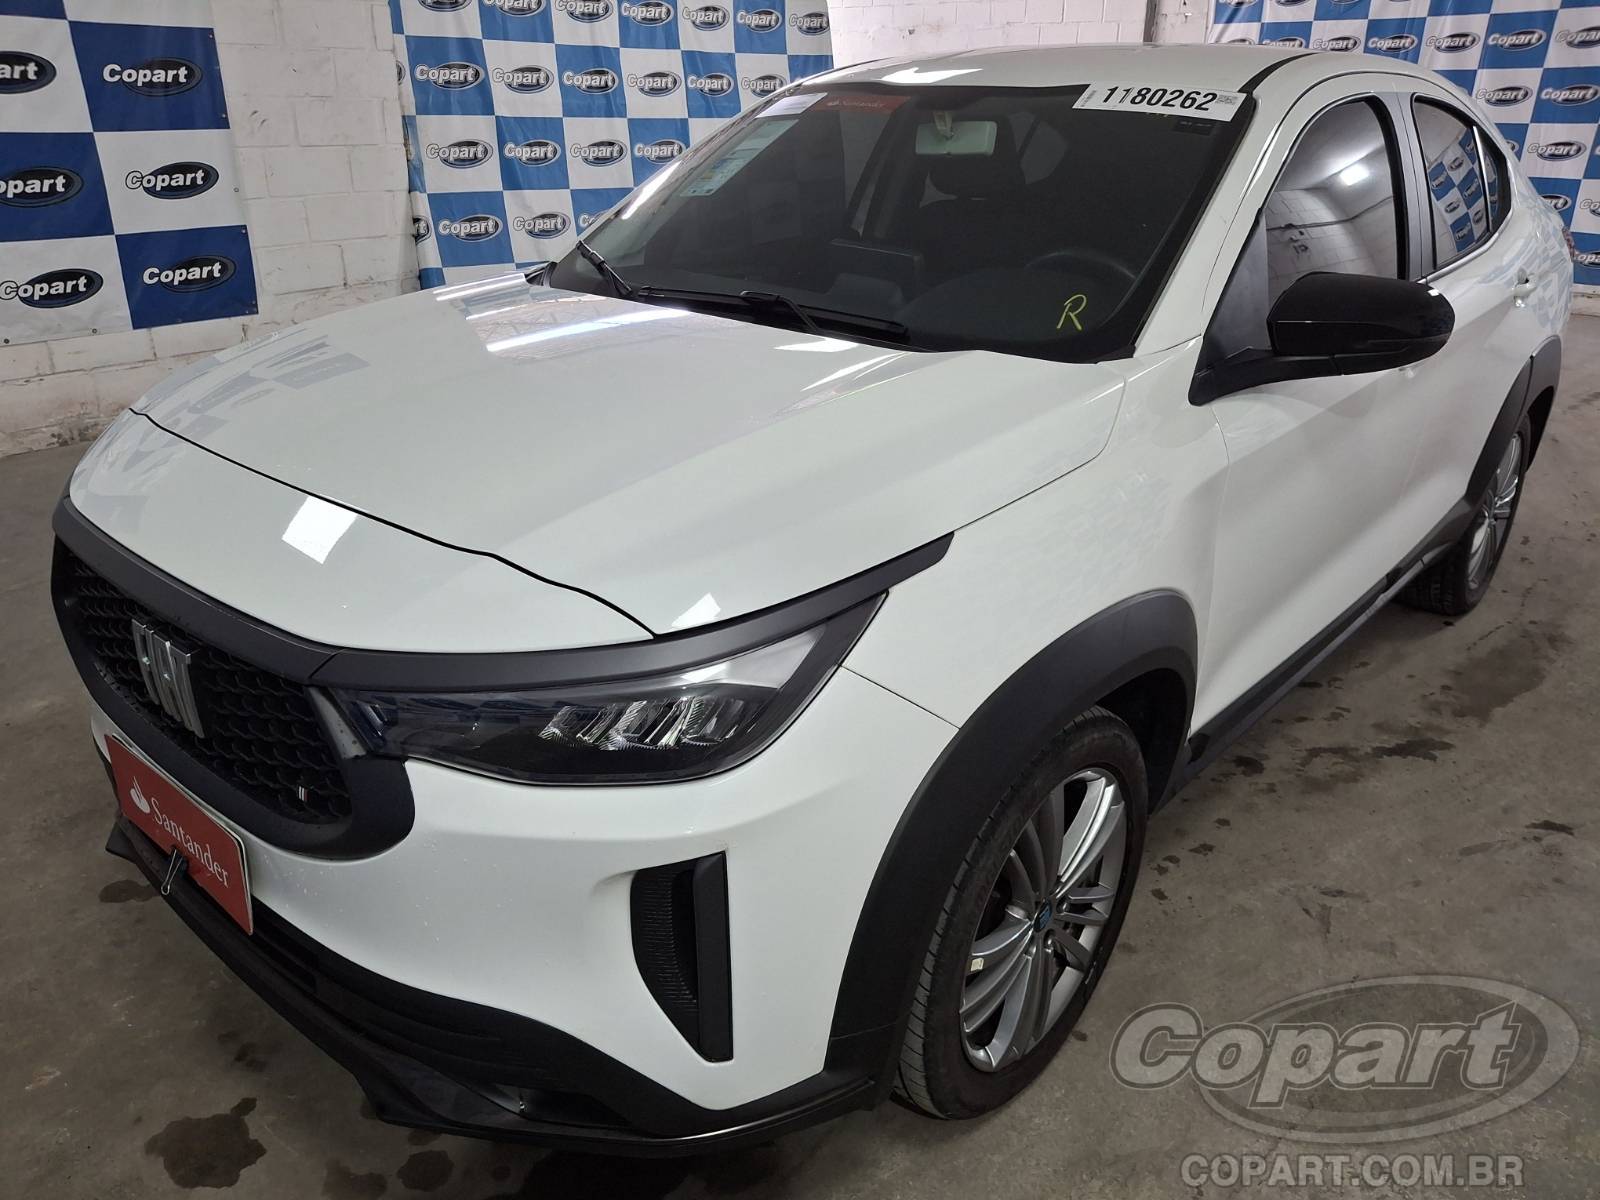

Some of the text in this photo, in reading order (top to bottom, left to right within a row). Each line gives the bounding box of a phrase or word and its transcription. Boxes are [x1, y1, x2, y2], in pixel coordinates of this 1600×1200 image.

[556, 0, 607, 14] Copart
[622, 3, 668, 20] Copart
[683, 7, 725, 23] Copart
[737, 11, 777, 27] Copart
[789, 14, 829, 29] Copart
[1313, 39, 1355, 50] Copart
[1368, 36, 1414, 50] Copart
[1426, 35, 1472, 49] Copart
[1488, 31, 1539, 47] Copart
[103, 64, 188, 86] Copart
[415, 65, 475, 85] Copart
[492, 68, 546, 84] Copart
[562, 71, 613, 87] Copart
[627, 73, 674, 91] Copart
[687, 75, 729, 91] Copart
[741, 77, 781, 91] Copart
[1102, 86, 1218, 111] 1180262
[1477, 88, 1527, 104] Copart
[1541, 86, 1593, 102] Copart
[425, 143, 485, 160] Copart
[504, 143, 553, 160] Copart
[570, 143, 620, 160] Copart
[634, 142, 680, 158] Copart
[1528, 143, 1577, 157] Copart
[126, 168, 204, 190] Copart
[438, 218, 494, 236] Copart
[513, 216, 563, 232] Copart
[143, 261, 222, 286] Copart
[0, 275, 88, 300] Copart
[1056, 294, 1087, 331] R
[151, 797, 230, 888] Santander
